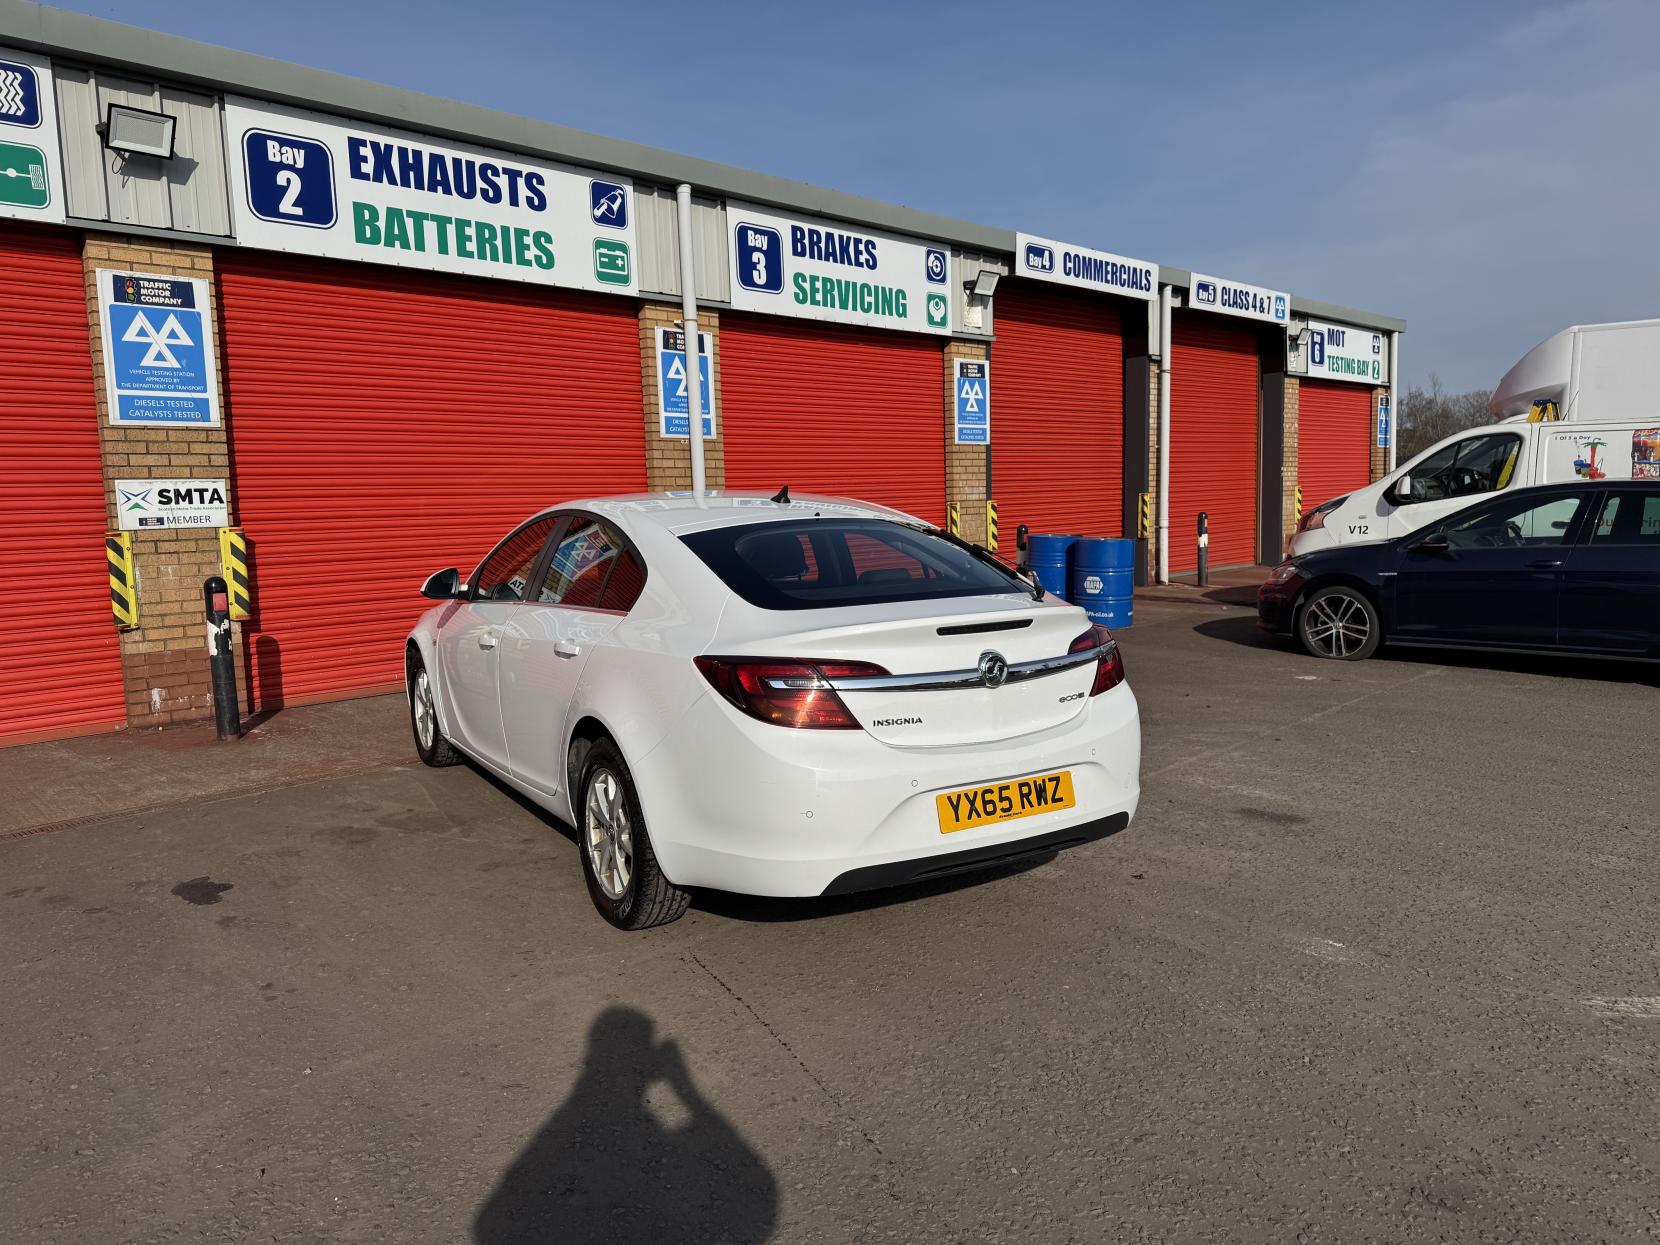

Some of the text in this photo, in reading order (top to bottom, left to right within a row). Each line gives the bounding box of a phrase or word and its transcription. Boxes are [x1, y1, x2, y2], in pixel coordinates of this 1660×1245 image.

[266, 140, 304, 168] Bay
[347, 136, 547, 212] EXHAUSTS
[276, 170, 303, 216] 2
[352, 201, 555, 270] BATTERIES
[747, 230, 768, 250] Bay
[791, 225, 877, 270] BRAKES
[751, 252, 766, 286] 3
[1029, 250, 1050, 269] Bay 4
[1063, 251, 1151, 292] COMMERCIALS
[139, 281, 171, 290] TRAFFIC
[140, 288, 170, 297] MOTOR
[793, 272, 907, 318] SERVICING
[1208, 285, 1214, 302] 5
[141, 296, 182, 305] COMPANY
[1221, 286, 1271, 315] CLASS 4 & 7
[1327, 328, 1345, 347] MOT
[1315, 343, 1320, 363] 6
[1327, 355, 1379, 379] TESTING BAY 2
[134, 399, 194, 408] DIESELS TESTED
[128, 409, 201, 419] CATALYSTS TESTED
[157, 488, 224, 505] SMTA
[166, 515, 211, 525] MEMBER
[872, 716, 923, 727] INSIGNIA
[947, 775, 1064, 823] YX65 RWZ
